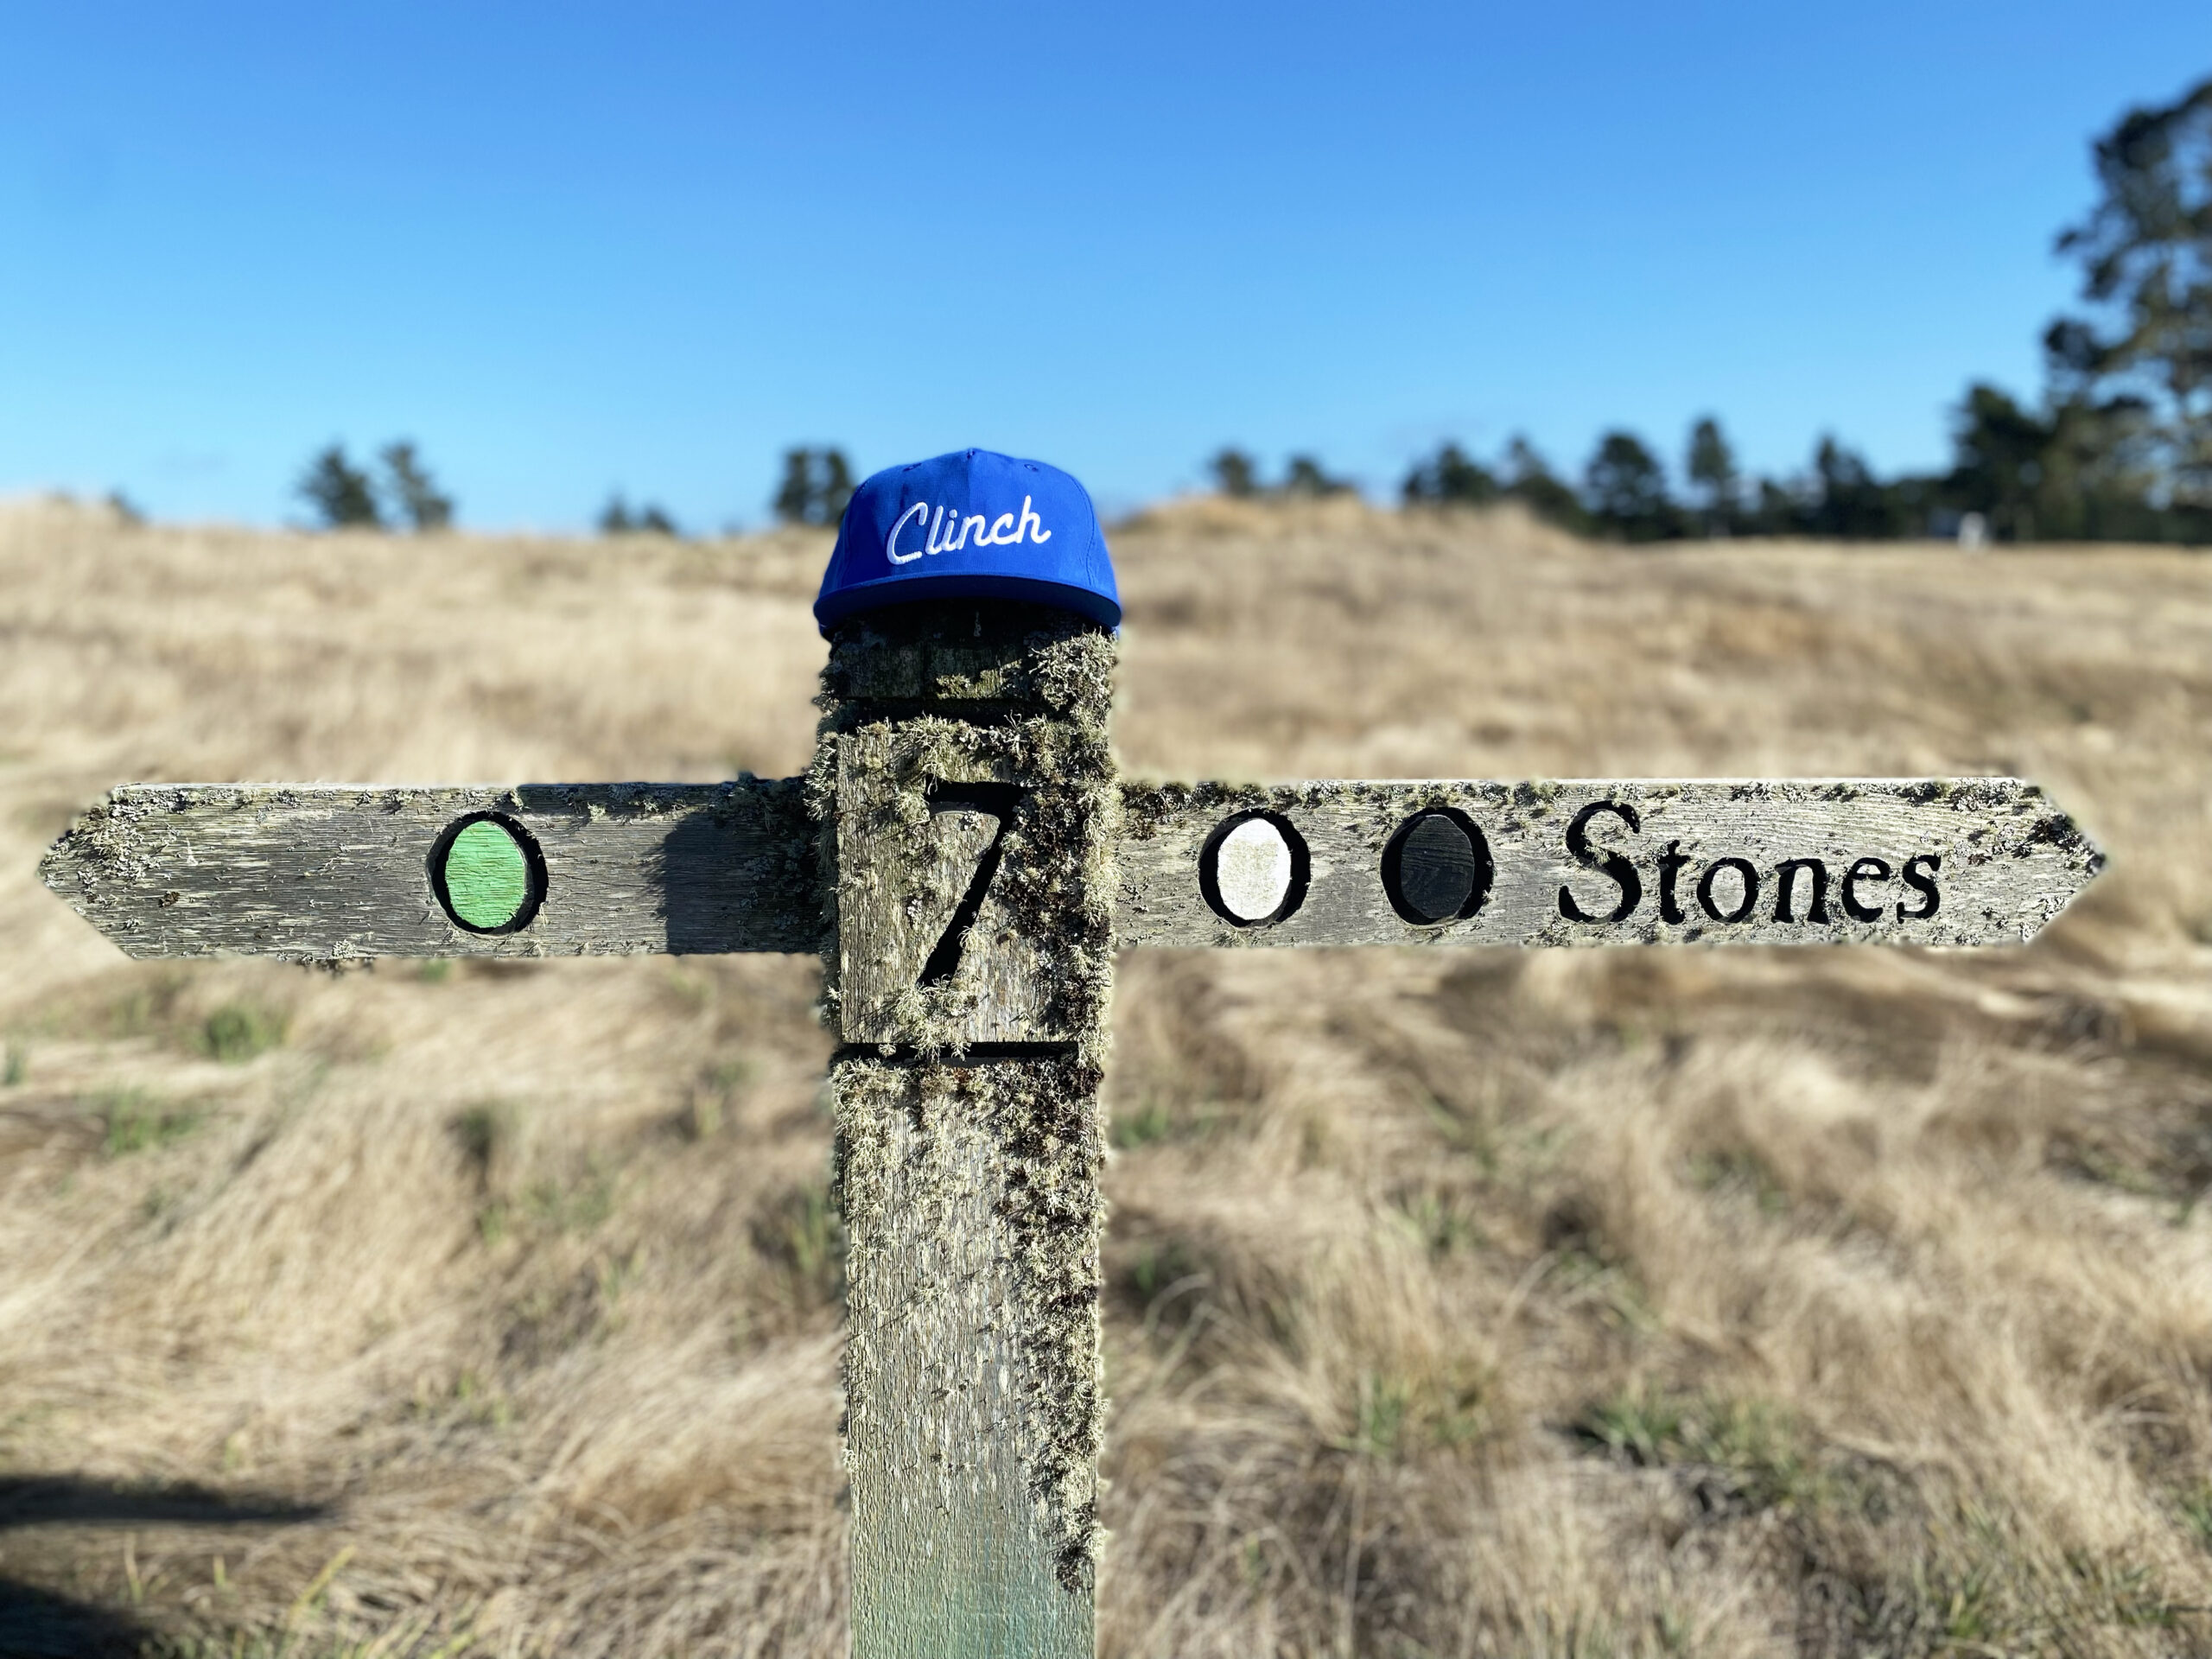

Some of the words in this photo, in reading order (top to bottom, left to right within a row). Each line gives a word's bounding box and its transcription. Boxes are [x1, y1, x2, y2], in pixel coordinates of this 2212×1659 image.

[887, 494, 1052, 565] Clinch
[918, 781, 1028, 988] 7
[1558, 800, 1942, 925] Stones
